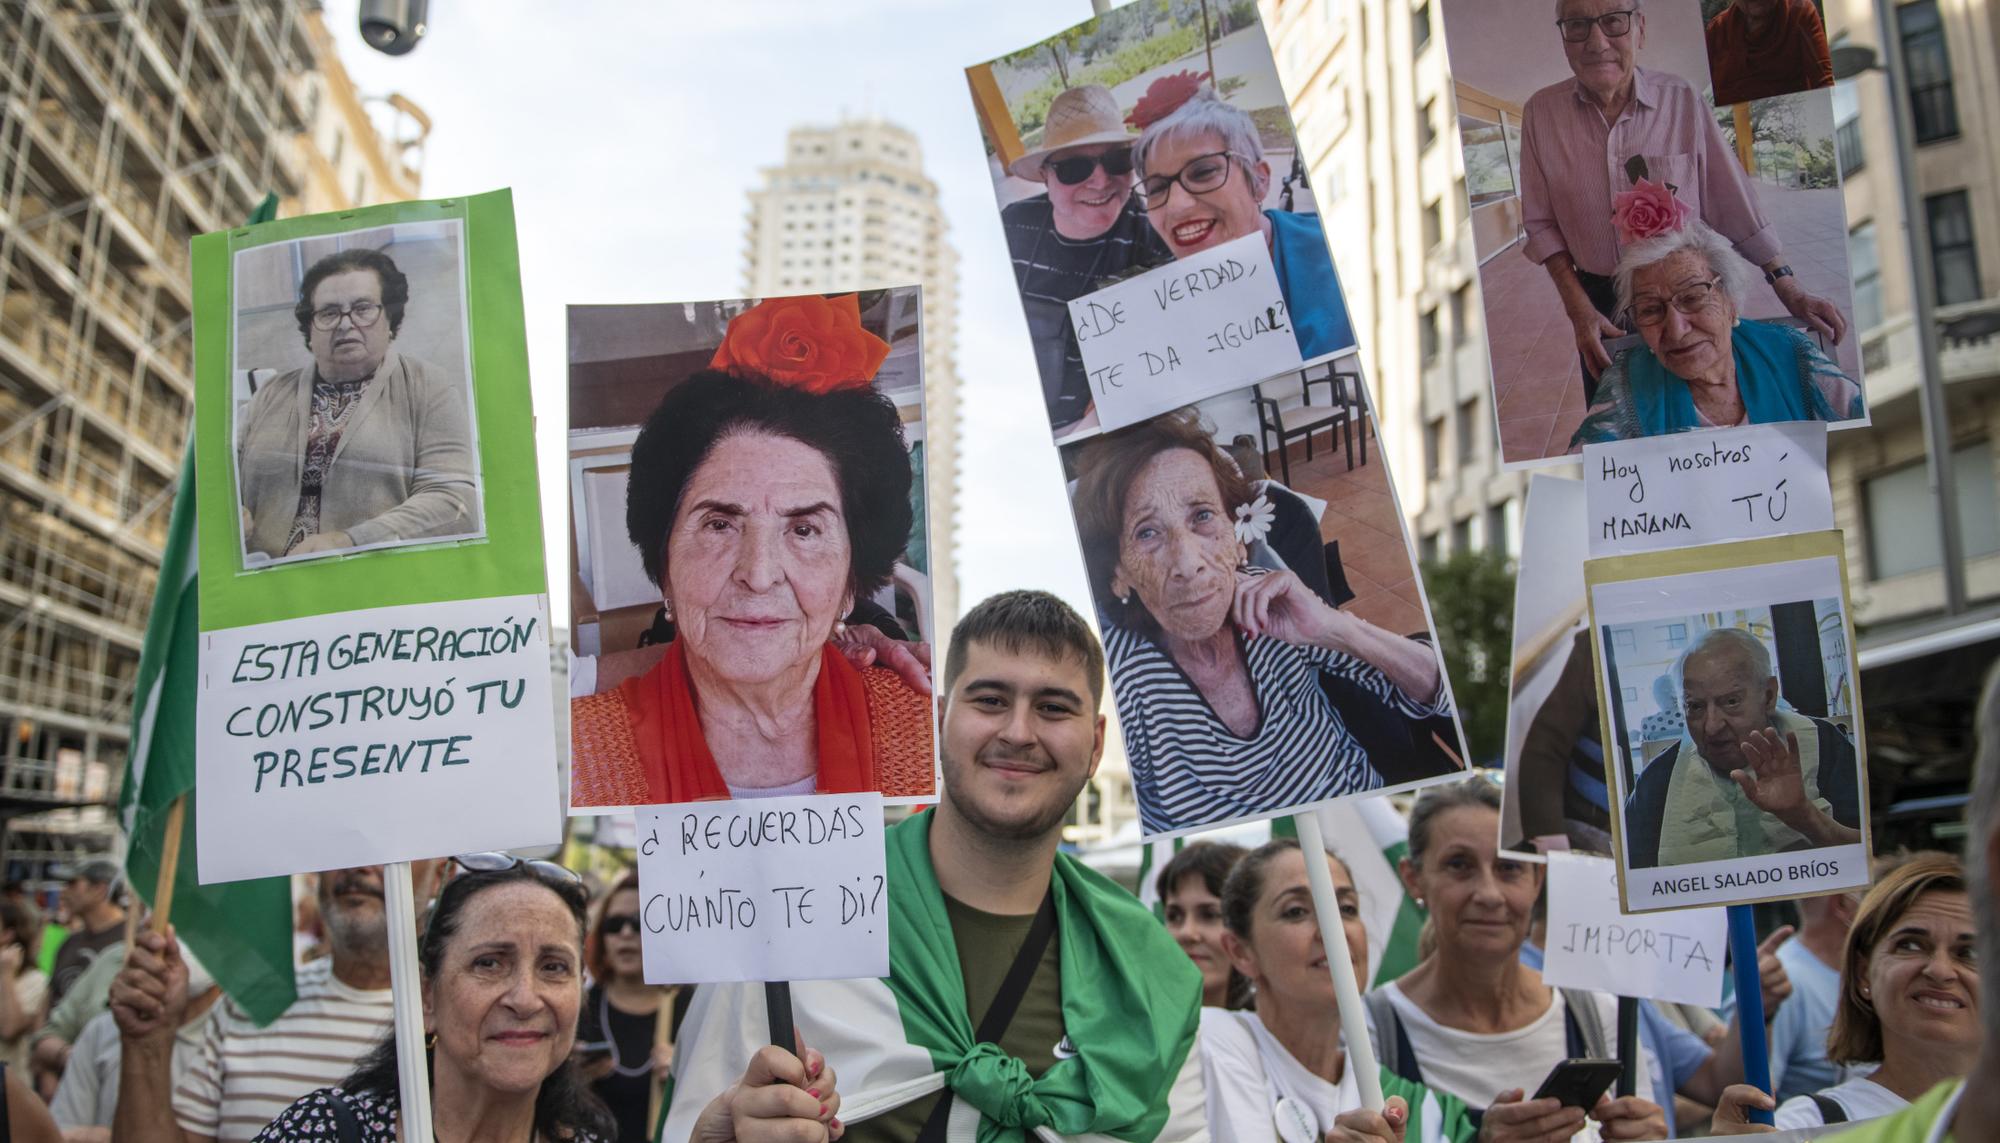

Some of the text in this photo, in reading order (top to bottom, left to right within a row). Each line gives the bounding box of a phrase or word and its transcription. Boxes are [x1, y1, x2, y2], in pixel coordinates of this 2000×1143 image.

[1075, 258, 1257, 342] ¿DE VERDAD,
[1089, 300, 1291, 396] TE DA IGUAL?
[1602, 440, 1752, 504] Hoy nosotros
[1602, 478, 1788, 541] MAÑANA TÚ
[231, 615, 538, 684] ESTA GENERACIÓN
[225, 676, 526, 739] CONSTRUYÓ TU
[252, 734, 474, 794] PRESENTE
[643, 869, 757, 934] CUÁNTO
[771, 886, 816, 929] TE
[1651, 859, 1840, 896] ANGEL SALADO BRÍOS
[1562, 923, 1713, 973] IMPORTA
